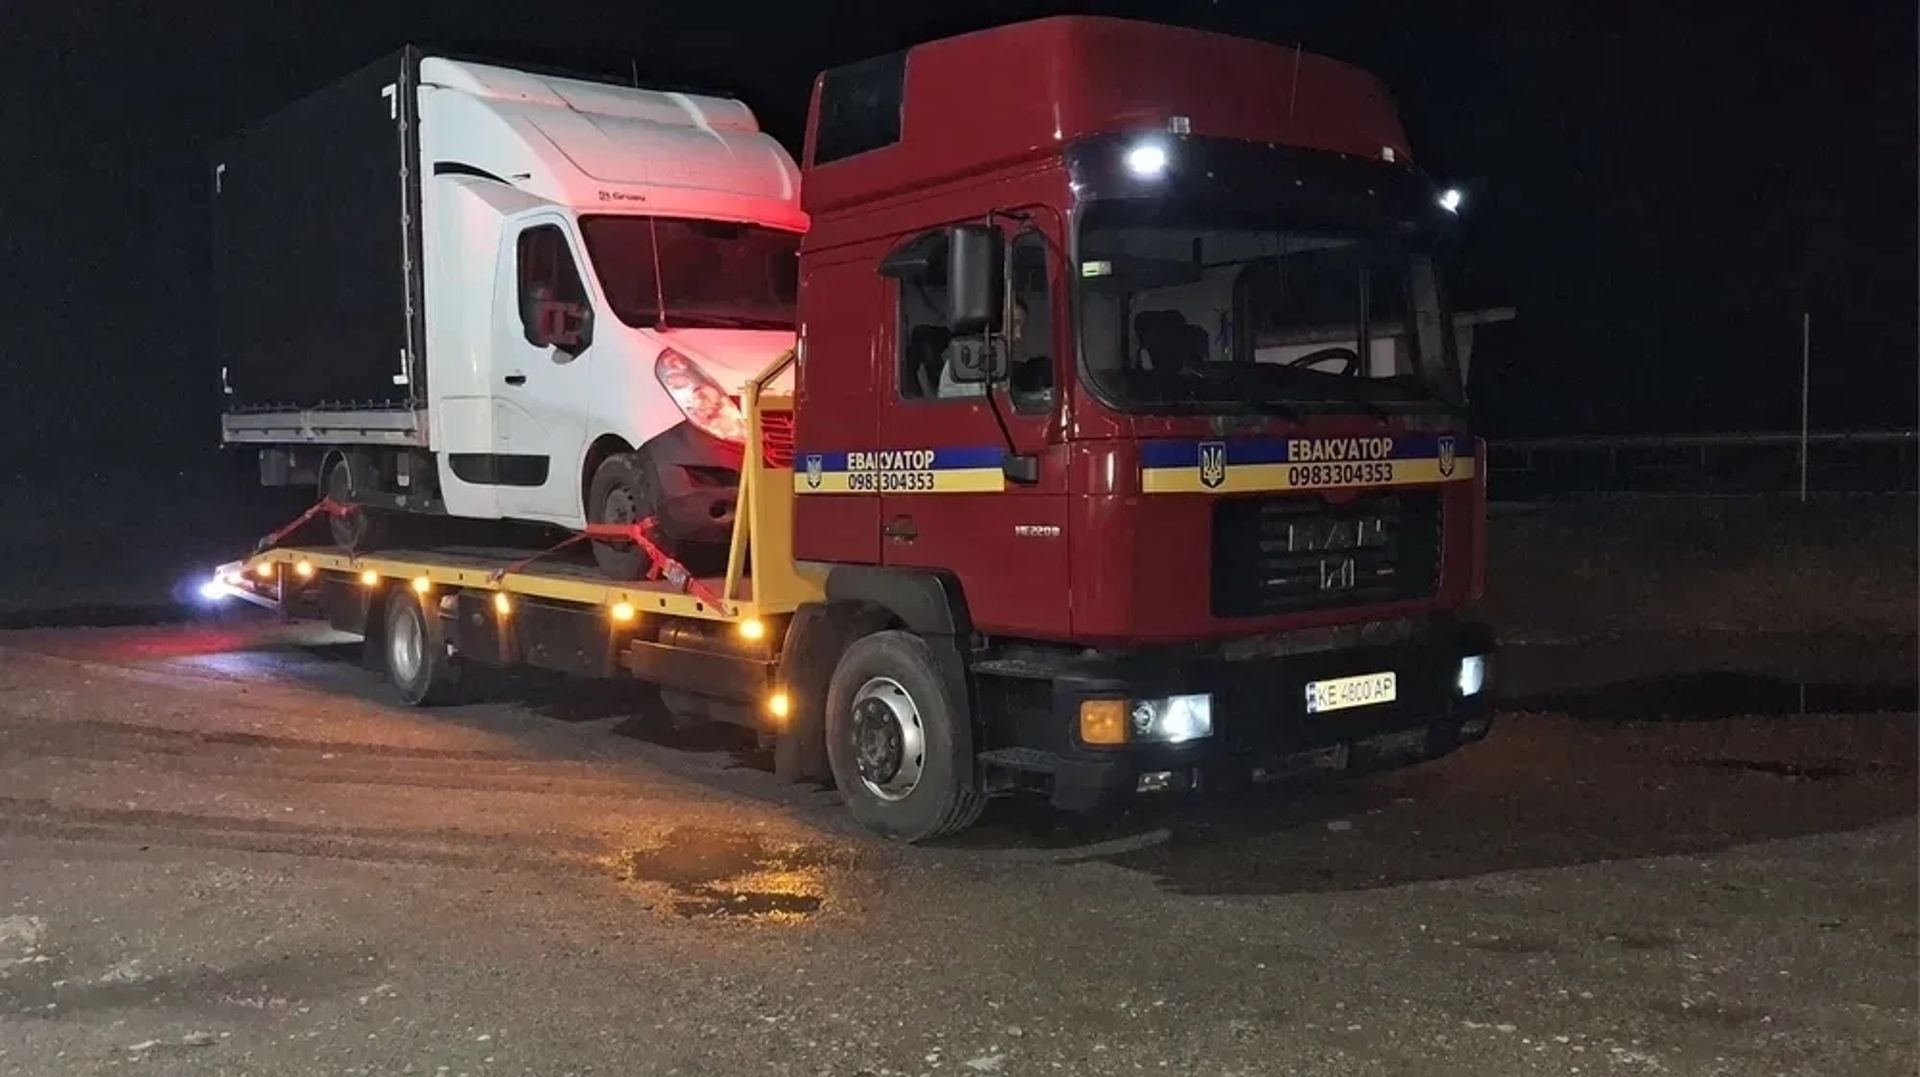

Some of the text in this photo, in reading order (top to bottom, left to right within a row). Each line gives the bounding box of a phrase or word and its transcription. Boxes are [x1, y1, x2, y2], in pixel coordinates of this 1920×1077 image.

[847, 450, 935, 470] ЕВАКУАТОР
[1287, 437, 1393, 461] ЕВАКУАТОР
[848, 472, 934, 490] 0983304353
[1287, 462, 1393, 486] 0983304353
